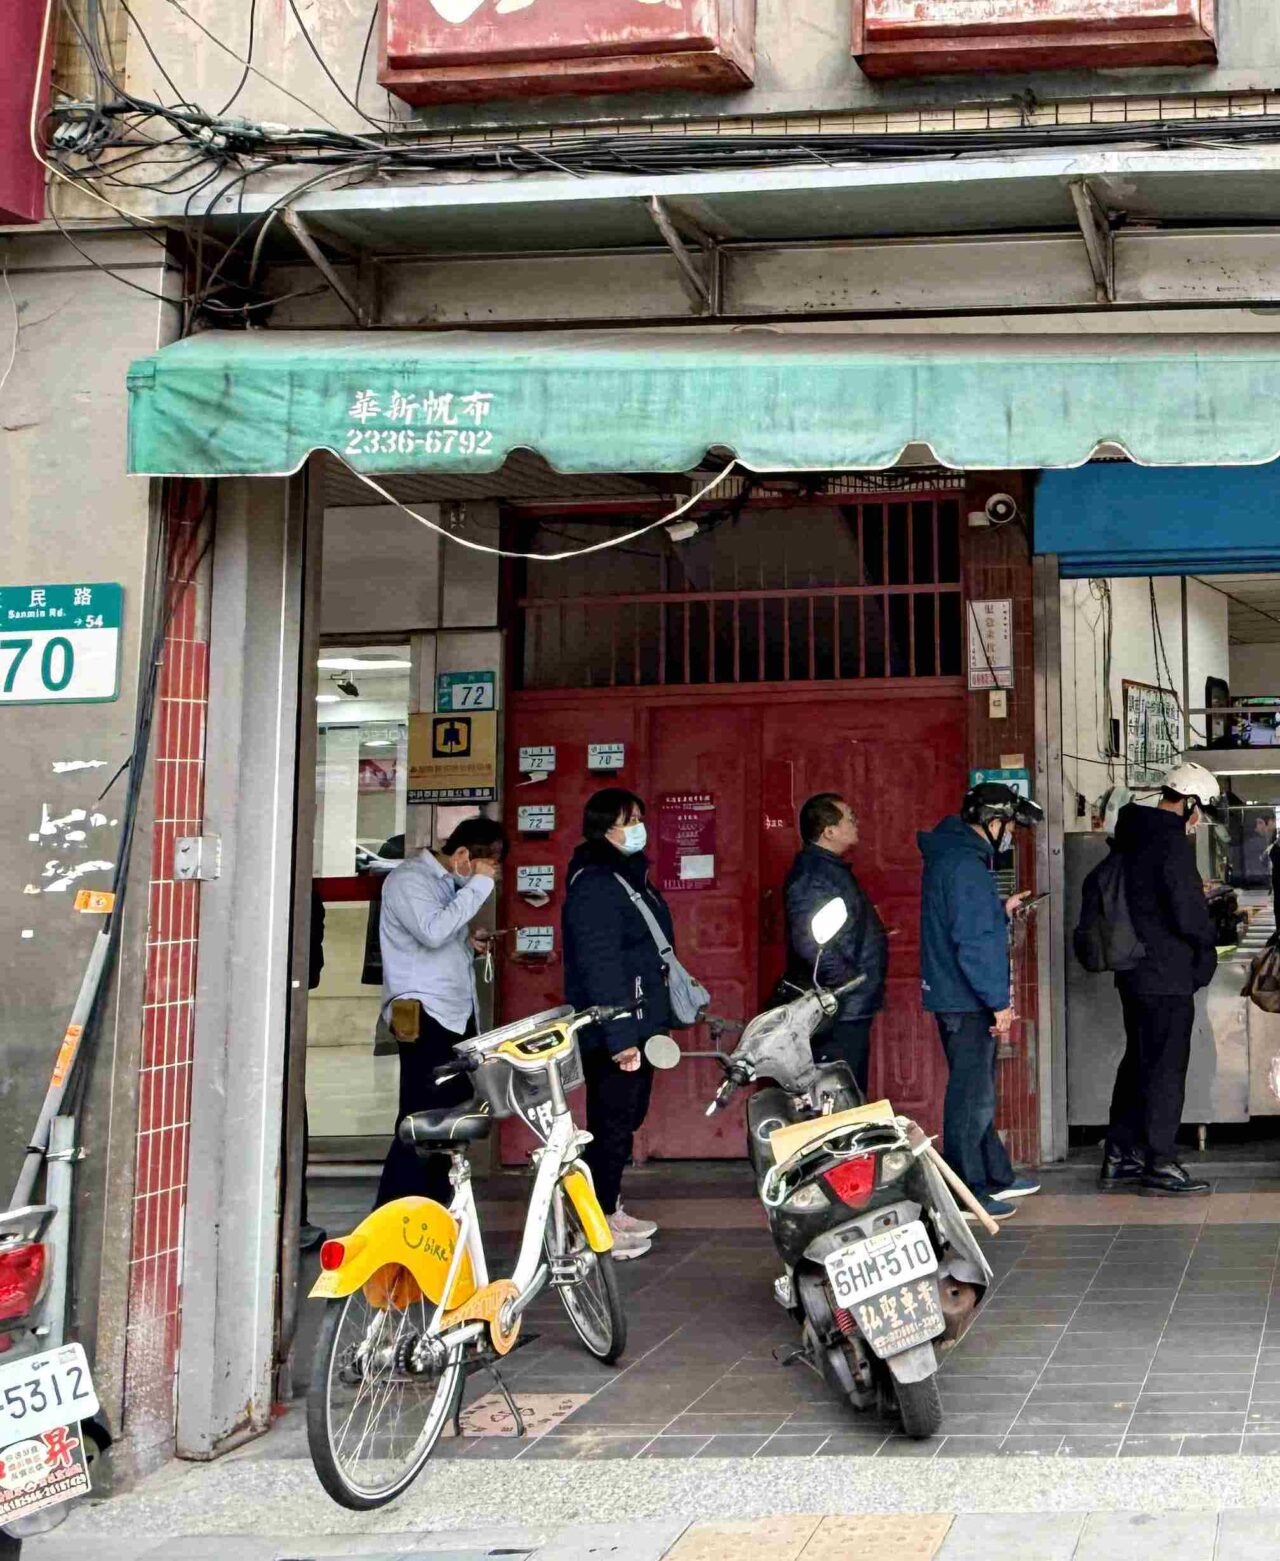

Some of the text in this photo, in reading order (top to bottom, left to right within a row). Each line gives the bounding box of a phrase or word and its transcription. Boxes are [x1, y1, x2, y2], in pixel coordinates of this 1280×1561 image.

[348, 389, 495, 426] 華新帆布
[345, 429, 493, 455] 2336-6792
[0, 587, 92, 608] 民路
[8, 608, 66, 619] Sanmin Rd.
[85, 614, 103, 628] 54
[0, 637, 74, 692] 70
[461, 686, 485, 706] 72
